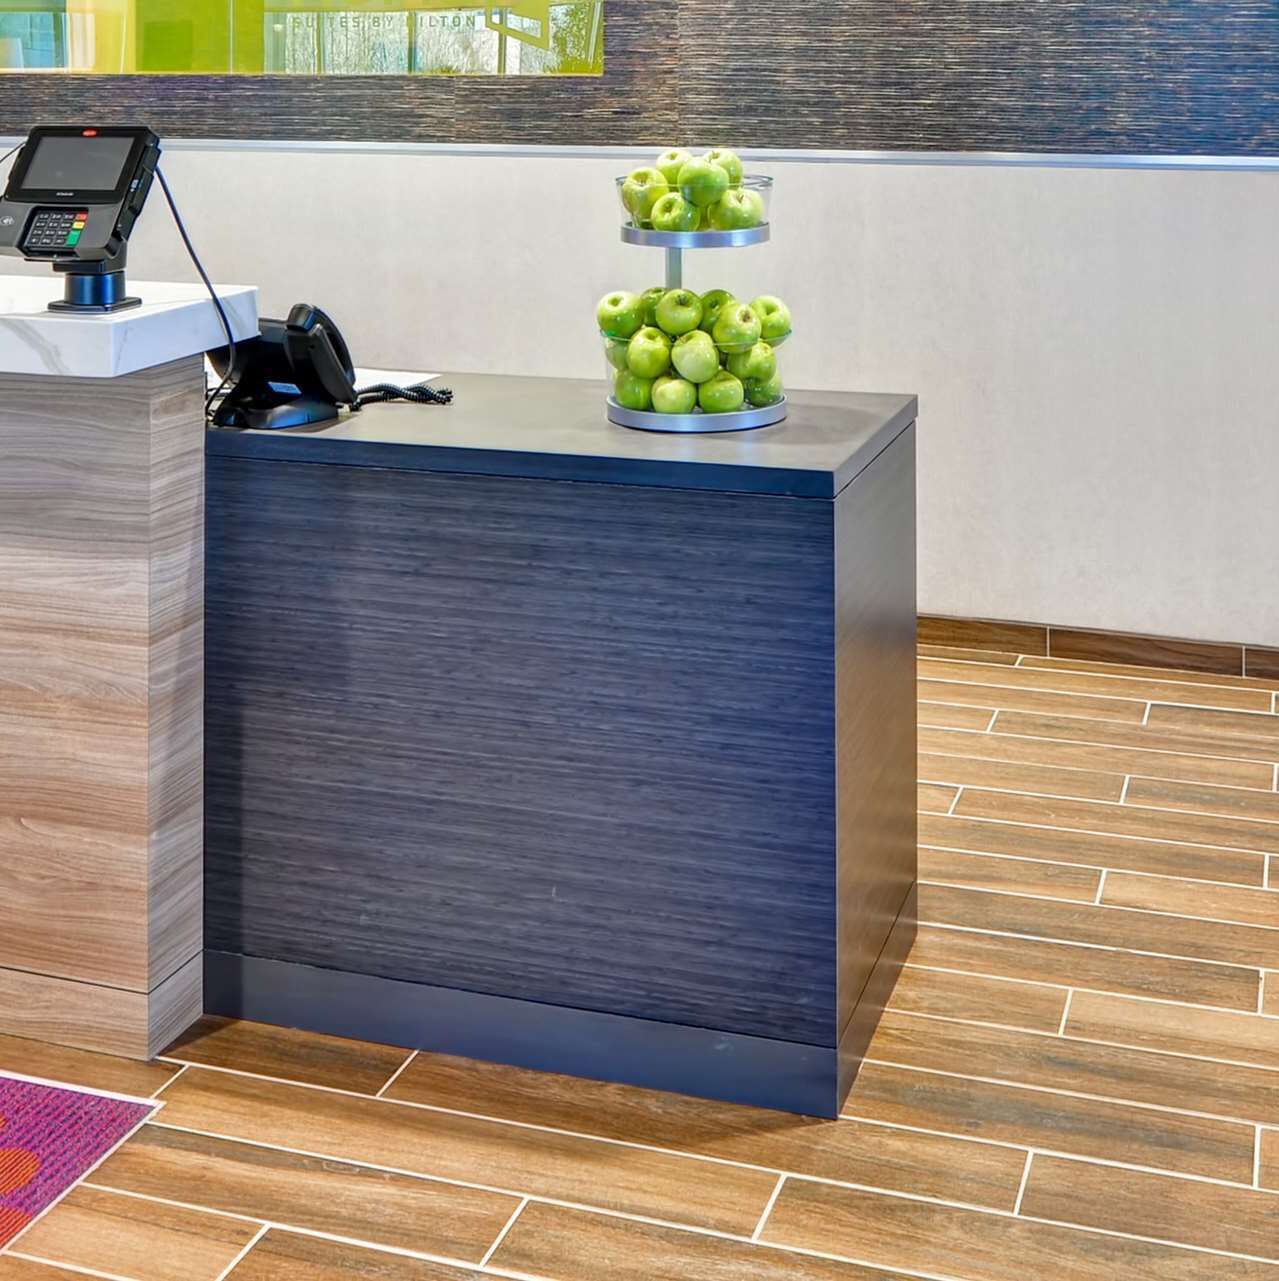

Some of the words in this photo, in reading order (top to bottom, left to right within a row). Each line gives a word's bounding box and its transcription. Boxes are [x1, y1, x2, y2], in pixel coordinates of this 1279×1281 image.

[292, 15, 361, 28] SUTES
[372, 15, 394, 28] BY
[408, 13, 476, 28] ILTON
